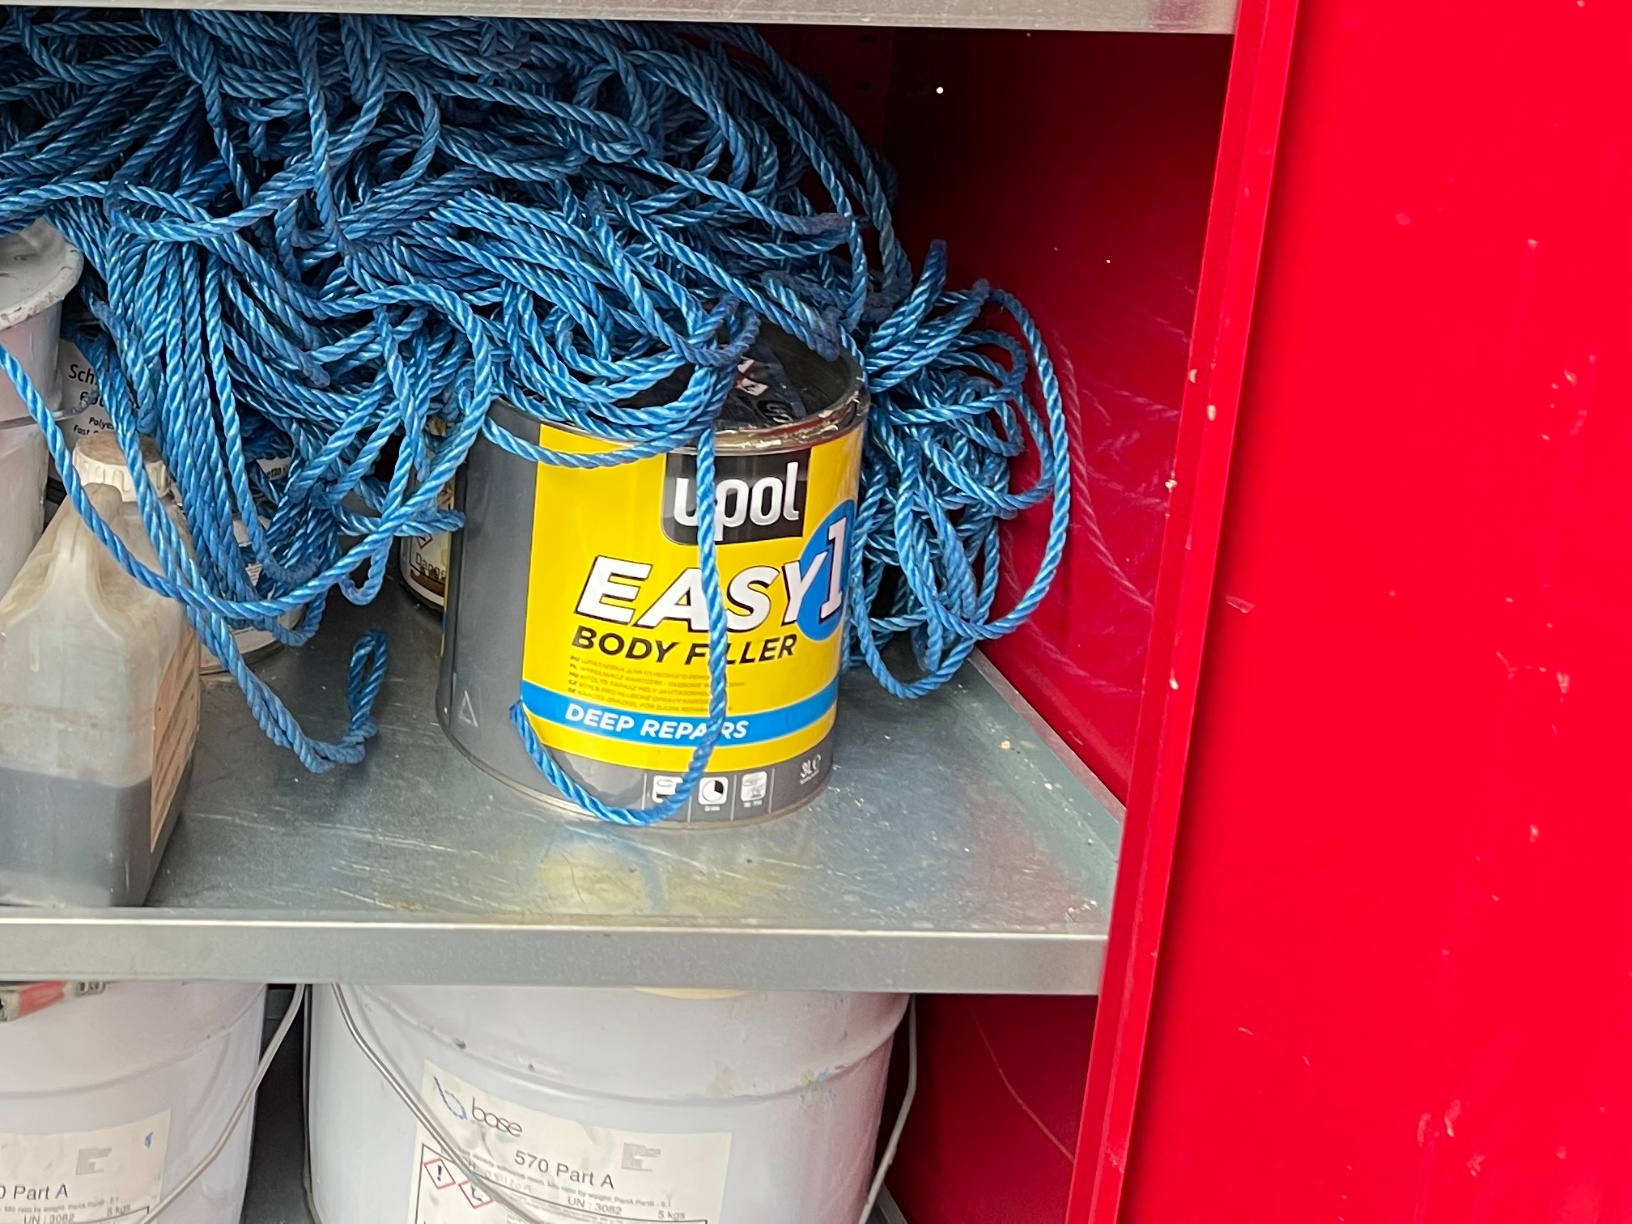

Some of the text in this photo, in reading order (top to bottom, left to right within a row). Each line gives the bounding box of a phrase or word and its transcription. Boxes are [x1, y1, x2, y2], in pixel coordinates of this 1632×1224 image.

[415, 551, 447, 580] Dange
[571, 625, 798, 666] BODY FLLER
[564, 702, 749, 740] DEEP REPARS
[471, 1095, 523, 1137] base
[514, 1149, 615, 1189] 570 Part A
[13, 1184, 50, 1201] Part
[55, 1183, 69, 1199] A
[594, 1201, 622, 1215] 3082
